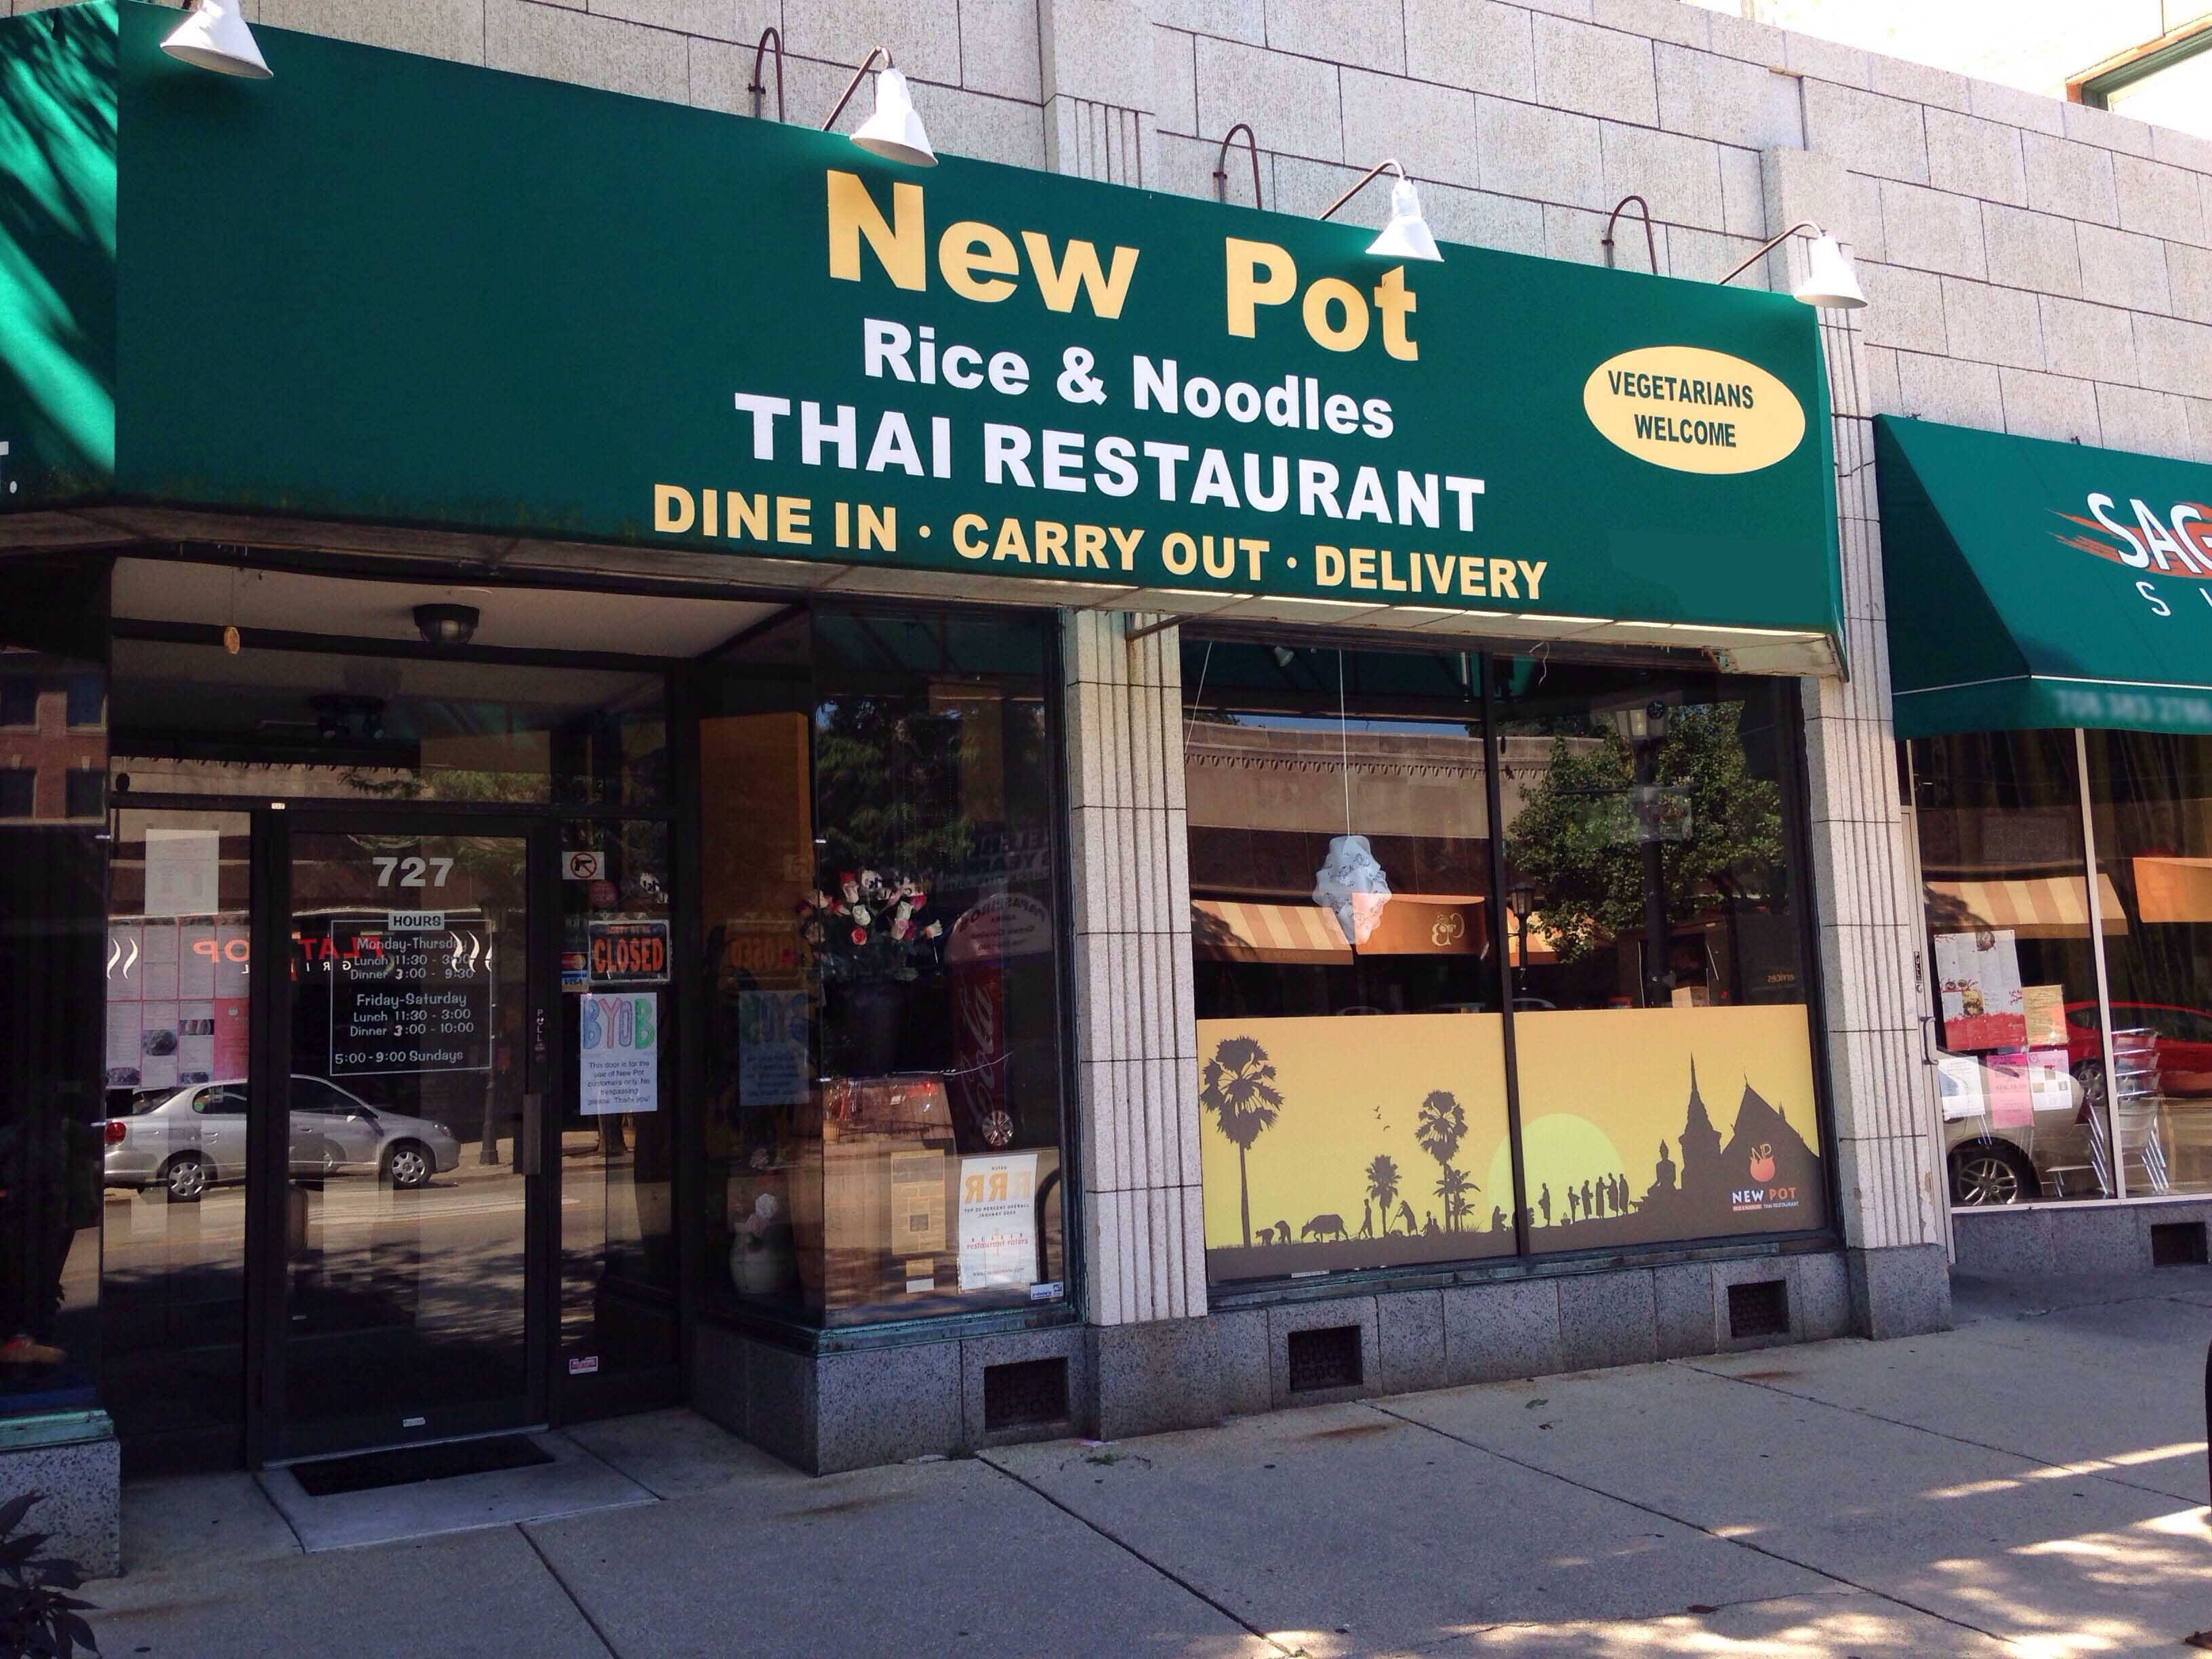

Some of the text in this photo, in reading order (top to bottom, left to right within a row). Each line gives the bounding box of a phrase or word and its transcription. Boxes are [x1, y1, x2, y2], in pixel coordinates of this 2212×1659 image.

[827, 169, 1418, 361] New Pot
[864, 318, 1394, 438] Rice & Noodles
[1607, 370, 1754, 409] VEGETARIANS
[1634, 413, 1736, 448] WELCOME
[735, 392, 1485, 532] THAI RESTAURANT
[654, 484, 1547, 600] DINE IN CARRY OUT DELIVERY
[372, 857, 453, 887] 727
[393, 916, 441, 927] HOURS
[357, 936, 468, 954] Monday-Thursday
[354, 955, 388, 966] Lunch
[395, 954, 428, 966] 11:30
[593, 937, 663, 973] CLOSED
[350, 969, 388, 980] Dinner
[395, 968, 426, 980] 3:00
[445, 967, 474, 979] 9:30
[356, 991, 468, 1010] Friday-Saturday
[353, 1011, 388, 1023] Lunch
[395, 1010, 428, 1021] 11:30
[441, 1008, 472, 1021] 3:00
[583, 997, 656, 1050] BYOB
[350, 1025, 388, 1038] Dinner
[393, 1024, 427, 1038] 3:00
[441, 1022, 475, 1033] 10:00
[409, 1050, 464, 1064] Sundays
[600, 1088, 639, 1096] trespassing
[1732, 1187, 1797, 1204] NEW POT
